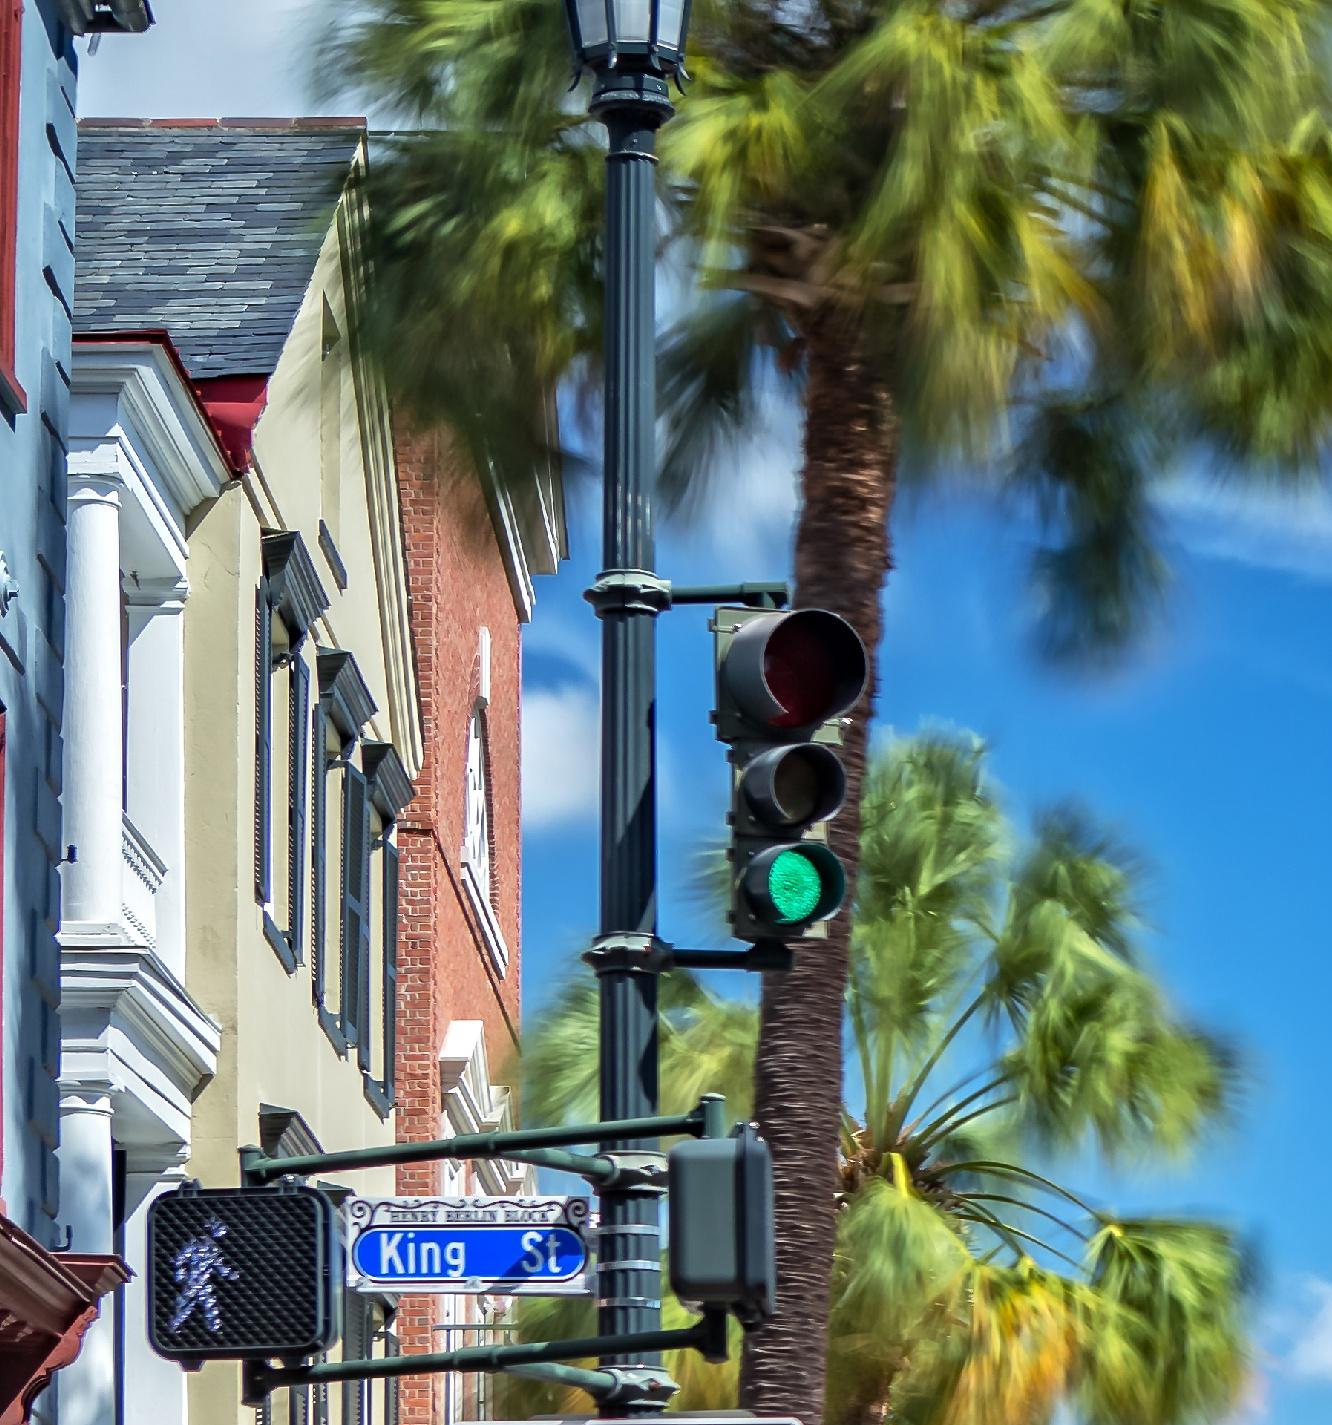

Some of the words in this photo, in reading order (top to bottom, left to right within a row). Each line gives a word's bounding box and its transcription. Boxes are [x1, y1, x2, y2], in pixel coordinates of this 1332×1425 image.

[390, 1210, 437, 1223] HENRY
[446, 1210, 497, 1223] BERLIN
[504, 1210, 549, 1223] BLOCK
[379, 1232, 466, 1278] King
[521, 1230, 563, 1274] St
